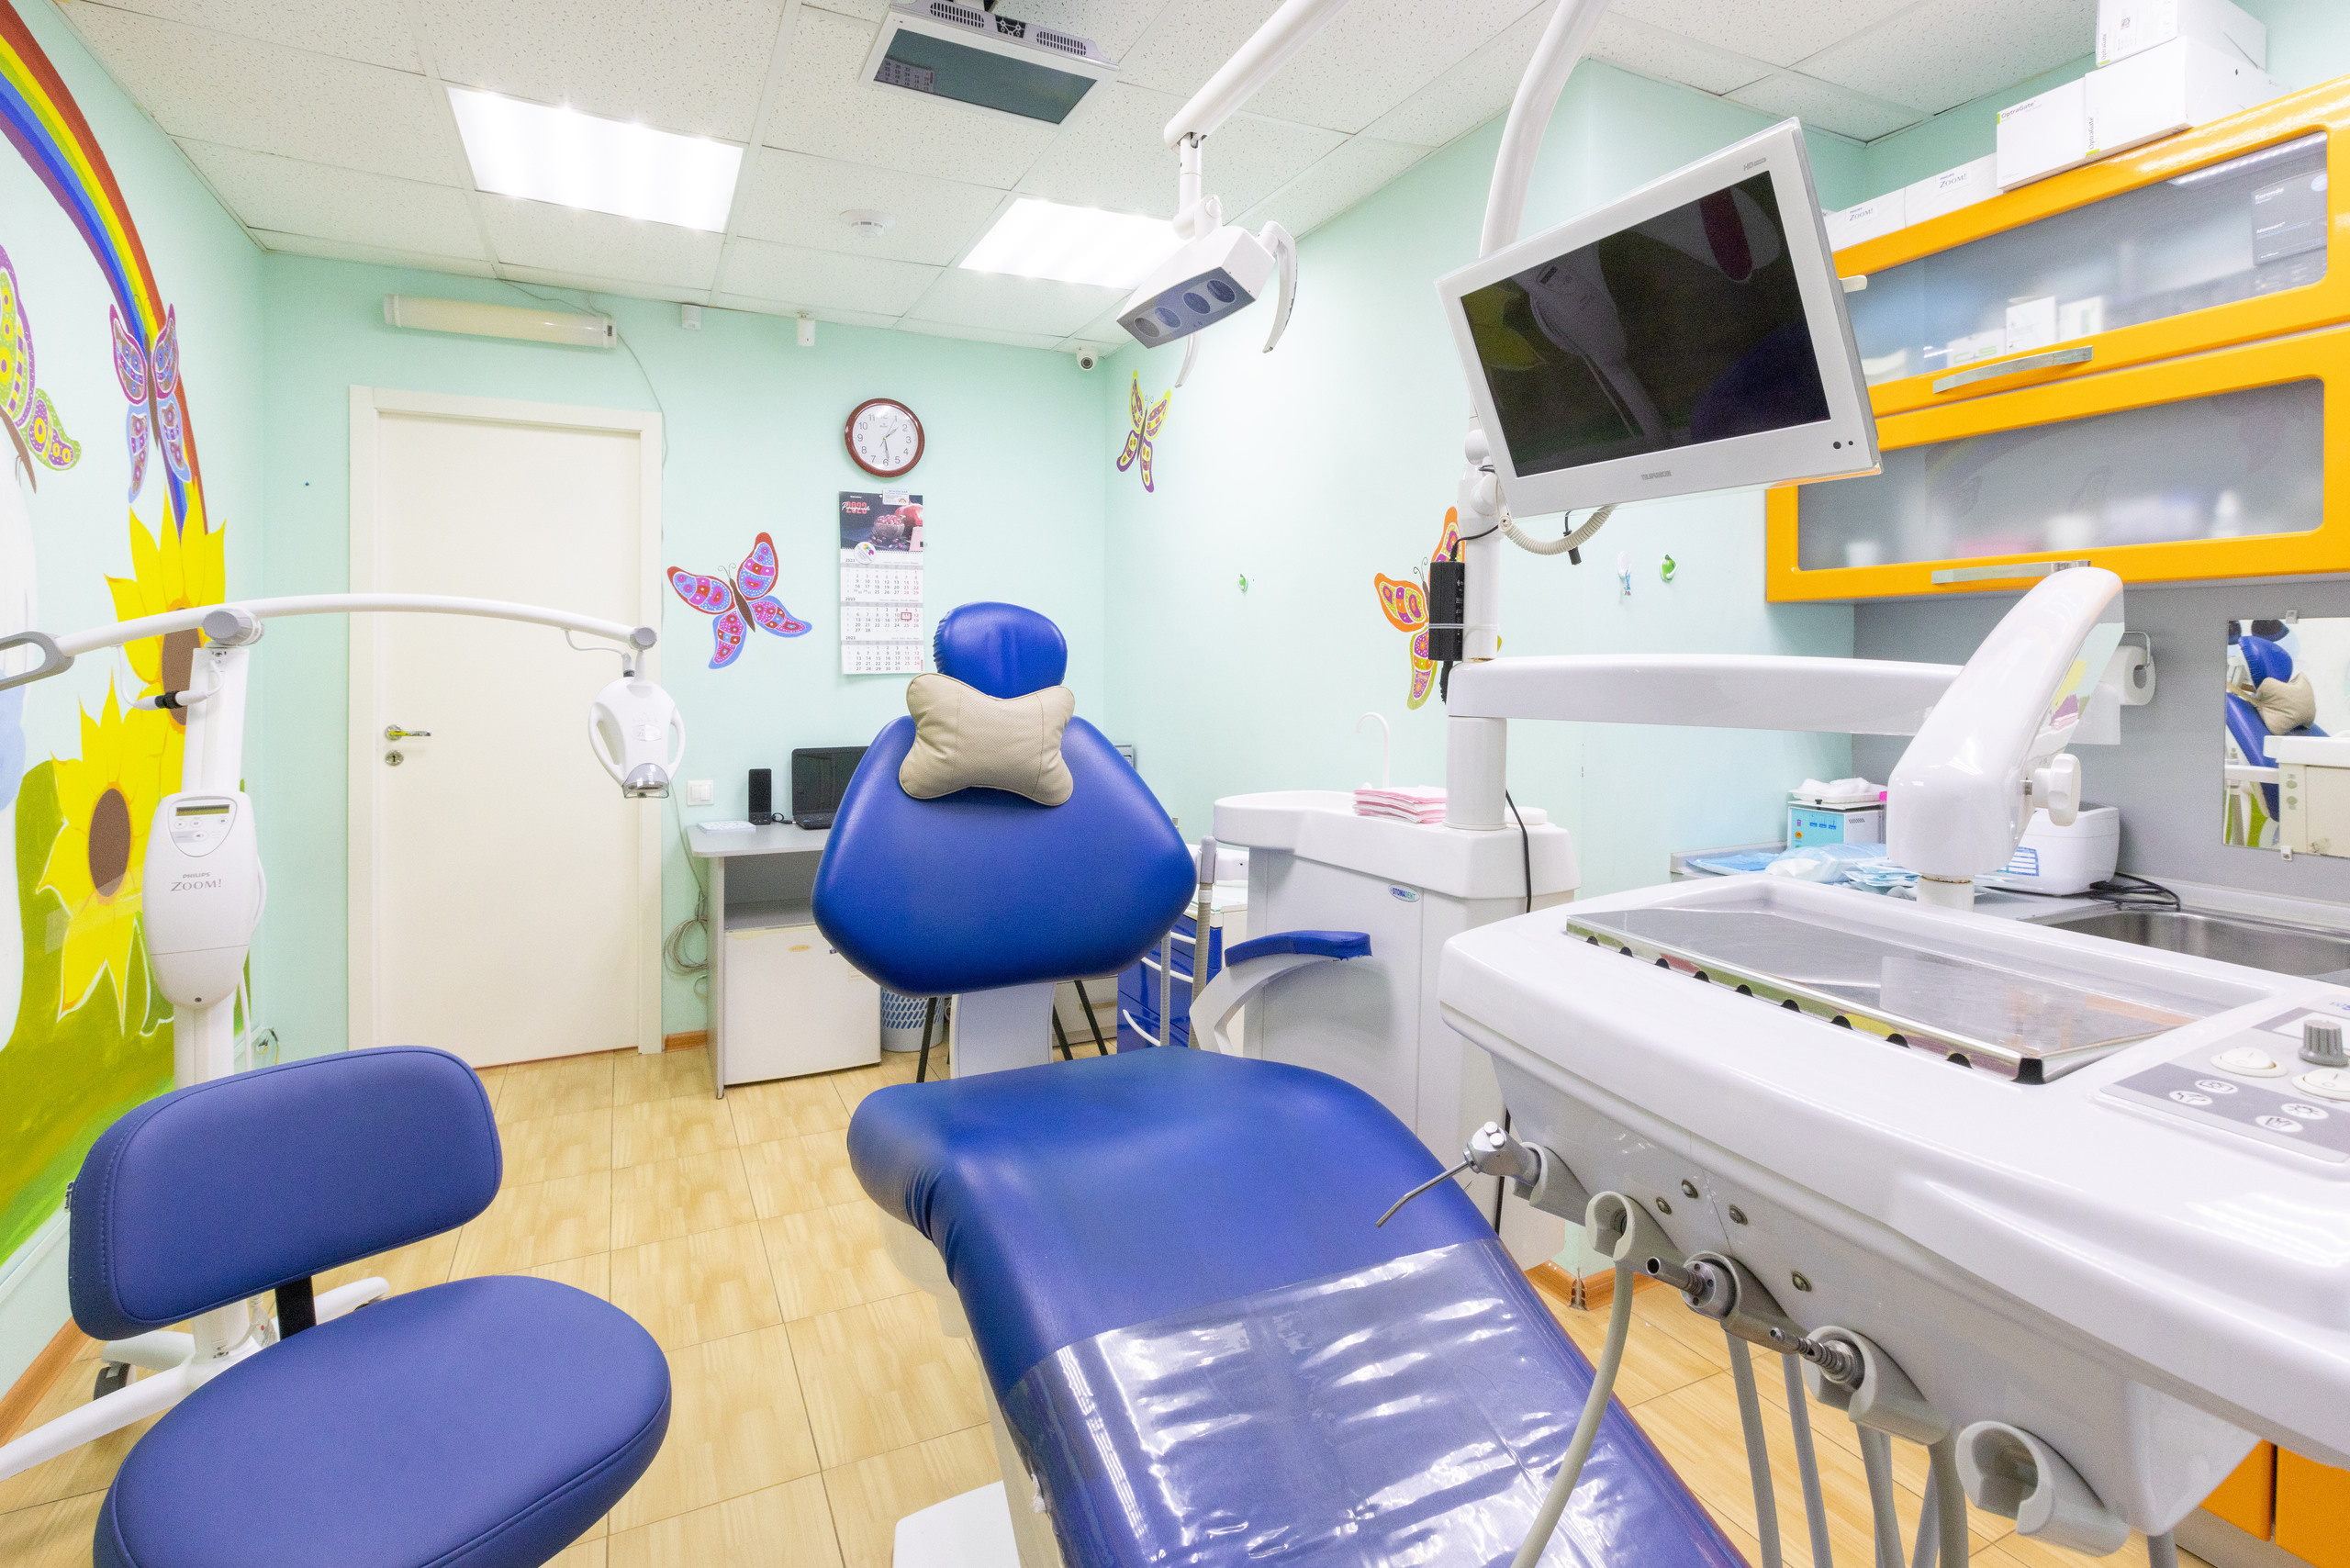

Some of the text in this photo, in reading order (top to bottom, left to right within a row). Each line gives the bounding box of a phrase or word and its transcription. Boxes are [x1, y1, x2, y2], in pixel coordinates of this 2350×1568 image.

[867, 413, 876, 421] 11
[859, 421, 868, 431] 10
[901, 423, 908, 432] 2
[857, 433, 864, 442] 9
[905, 436, 912, 444] 3
[861, 445, 867, 454] 8
[870, 454, 877, 464] 7
[882, 458, 890, 466] 6
[894, 455, 901, 465] 5
[170, 879, 221, 891] ZOOM!
